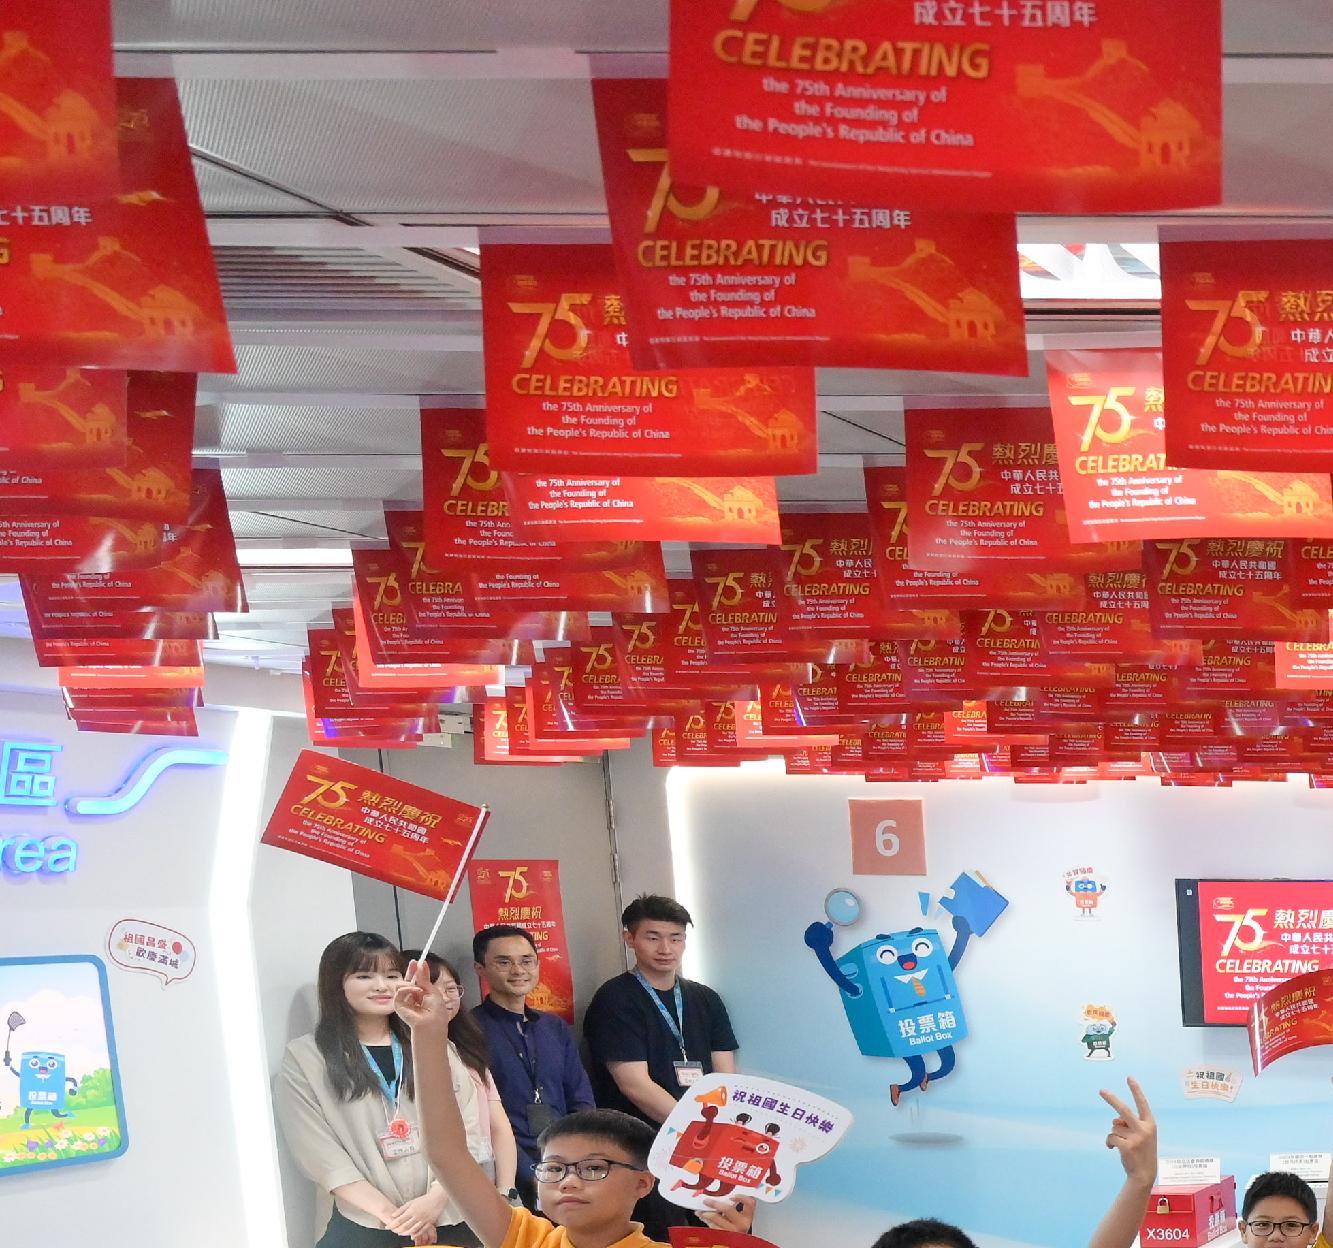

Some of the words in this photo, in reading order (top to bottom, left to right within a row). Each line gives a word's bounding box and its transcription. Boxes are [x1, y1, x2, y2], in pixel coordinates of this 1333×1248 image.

[914, 1, 1097, 27] 成立七十五周年
[713, 29, 991, 78] CELEBRATING
[763, 77, 789, 94] the
[796, 79, 829, 97] 75th
[834, 84, 925, 105] Anniversary
[931, 86, 947, 103] of
[794, 101, 819, 117] the
[825, 105, 897, 126] Founding
[903, 108, 919, 123] of
[736, 115, 762, 132] the
[768, 118, 833, 139] People's
[839, 124, 904, 144] Republic
[910, 127, 927, 143] of
[930, 129, 974, 147] China
[772, 209, 911, 229] 成立七十五周年
[637, 239, 828, 268] CELEBRATING
[512, 374, 678, 398] CELEBRATING
[0, 741, 63, 807] 區
[300, 775, 358, 809] 75
[358, 790, 442, 829] 熱烈慶祝
[291, 805, 387, 843] CELEBRATING
[876, 820, 900, 857] 6
[498, 867, 528, 903] 75
[1215, 959, 1319, 974] CELEBRATING
[899, 1011, 957, 1038] 投票箱
[909, 1034, 934, 1046] Ballot
[936, 1031, 952, 1042] Box
[733, 1090, 834, 1133] 祝祖國生日快樂
[718, 1156, 762, 1179] 投票箱
[1147, 1228, 1190, 1241] X3604
